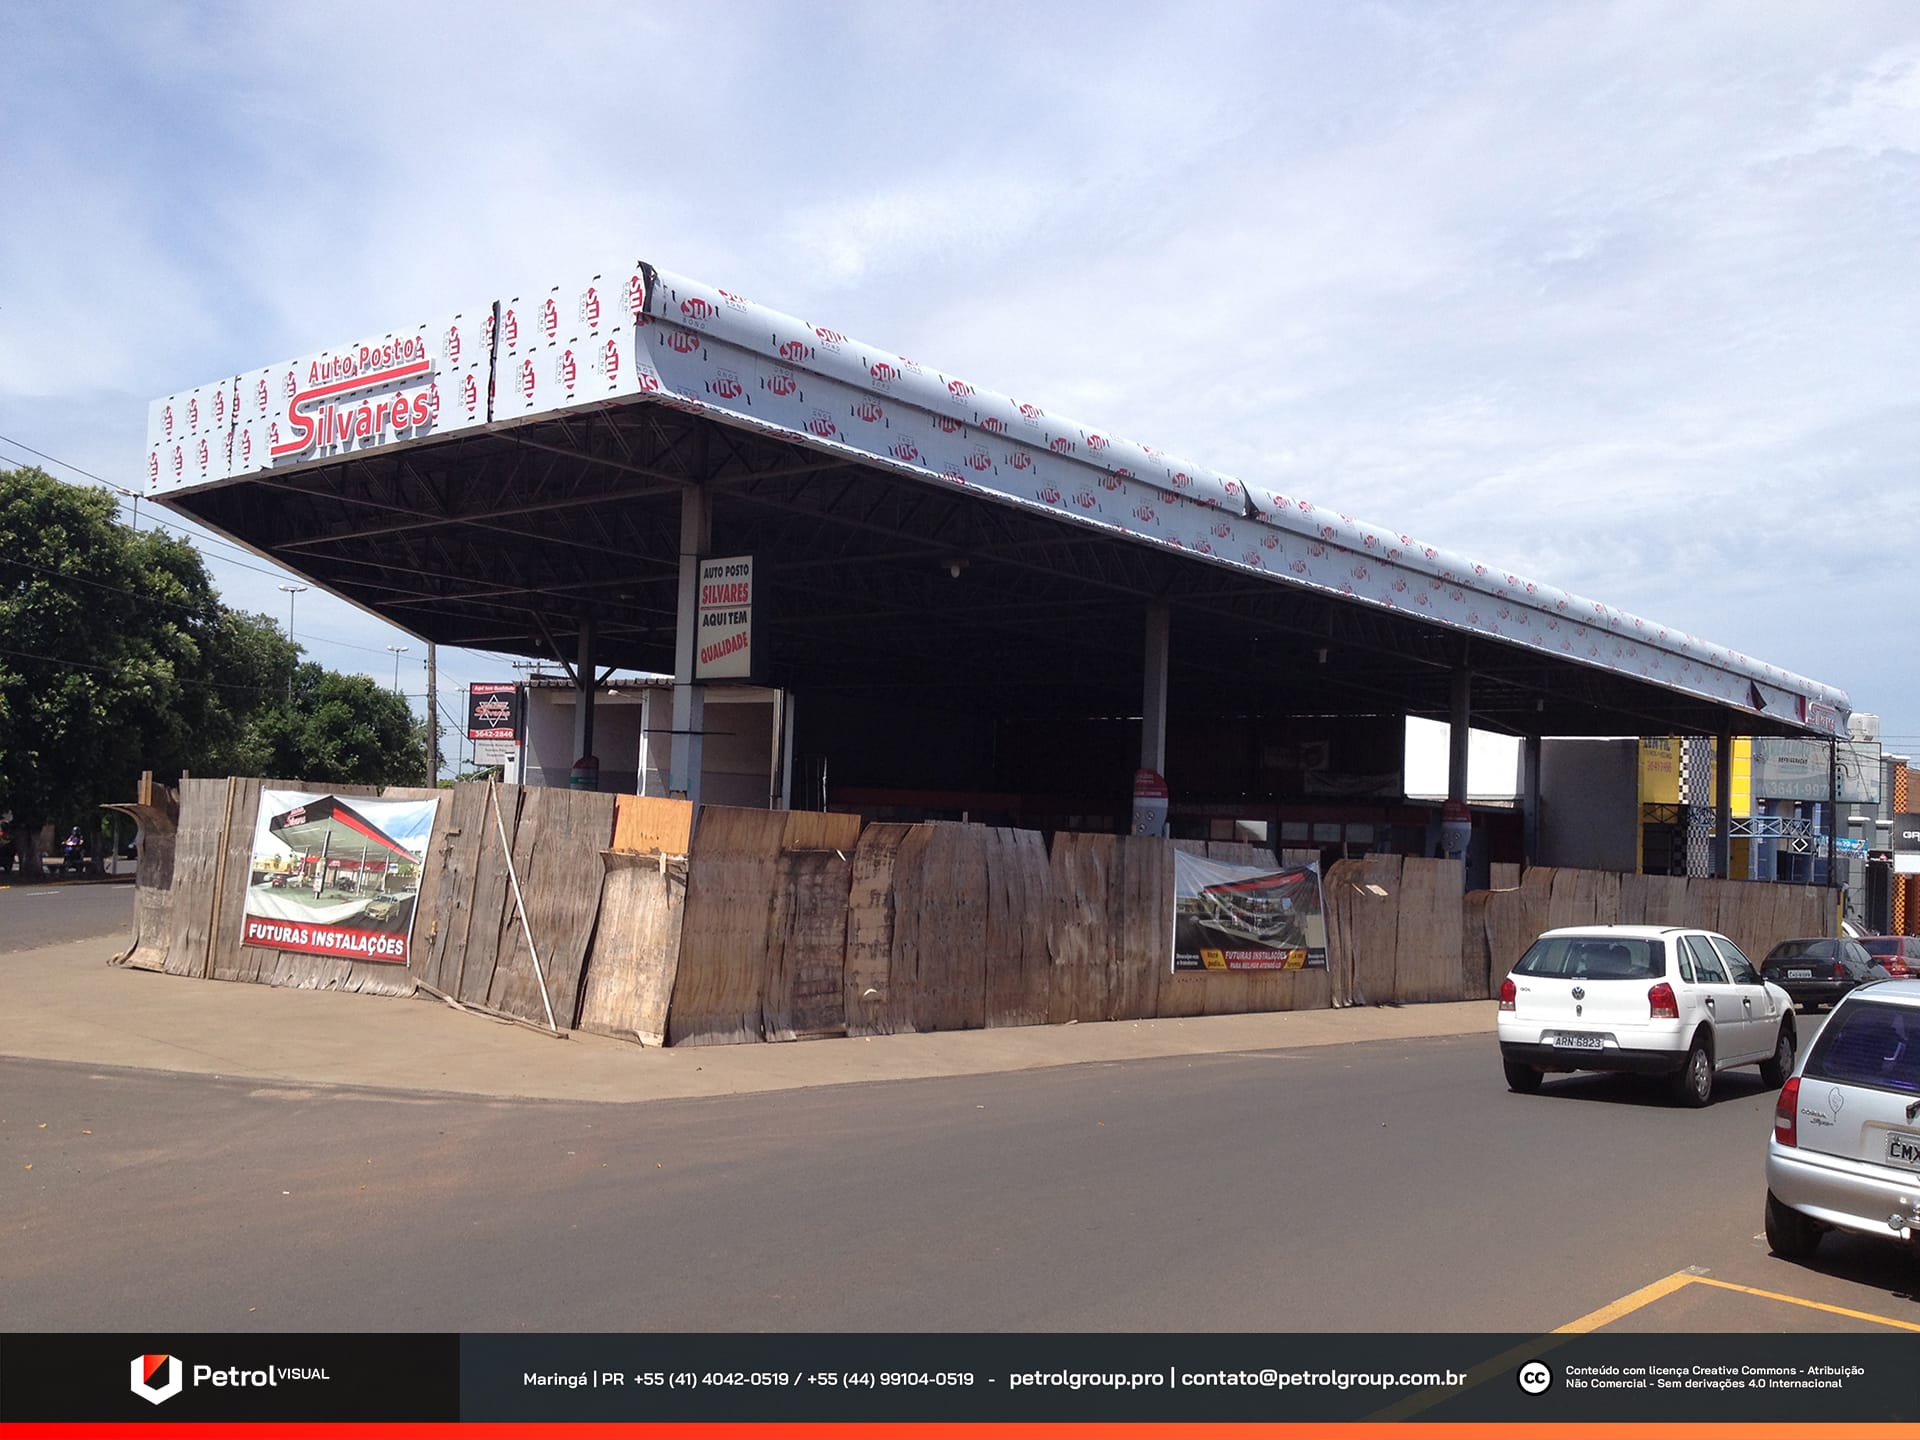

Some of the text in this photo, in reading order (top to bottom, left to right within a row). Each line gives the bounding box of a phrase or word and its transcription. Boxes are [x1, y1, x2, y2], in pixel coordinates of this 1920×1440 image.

[309, 338, 413, 383] Auto Posto
[704, 564, 749, 579] AUTO POSTO
[703, 583, 748, 604] SILVARES
[702, 611, 747, 627] AQUI TEM
[701, 632, 748, 664] QUALIDADE
[249, 924, 403, 955] FUTURAS INSTALAÇÕES
[1225, 951, 1252, 959] FUTURAS
